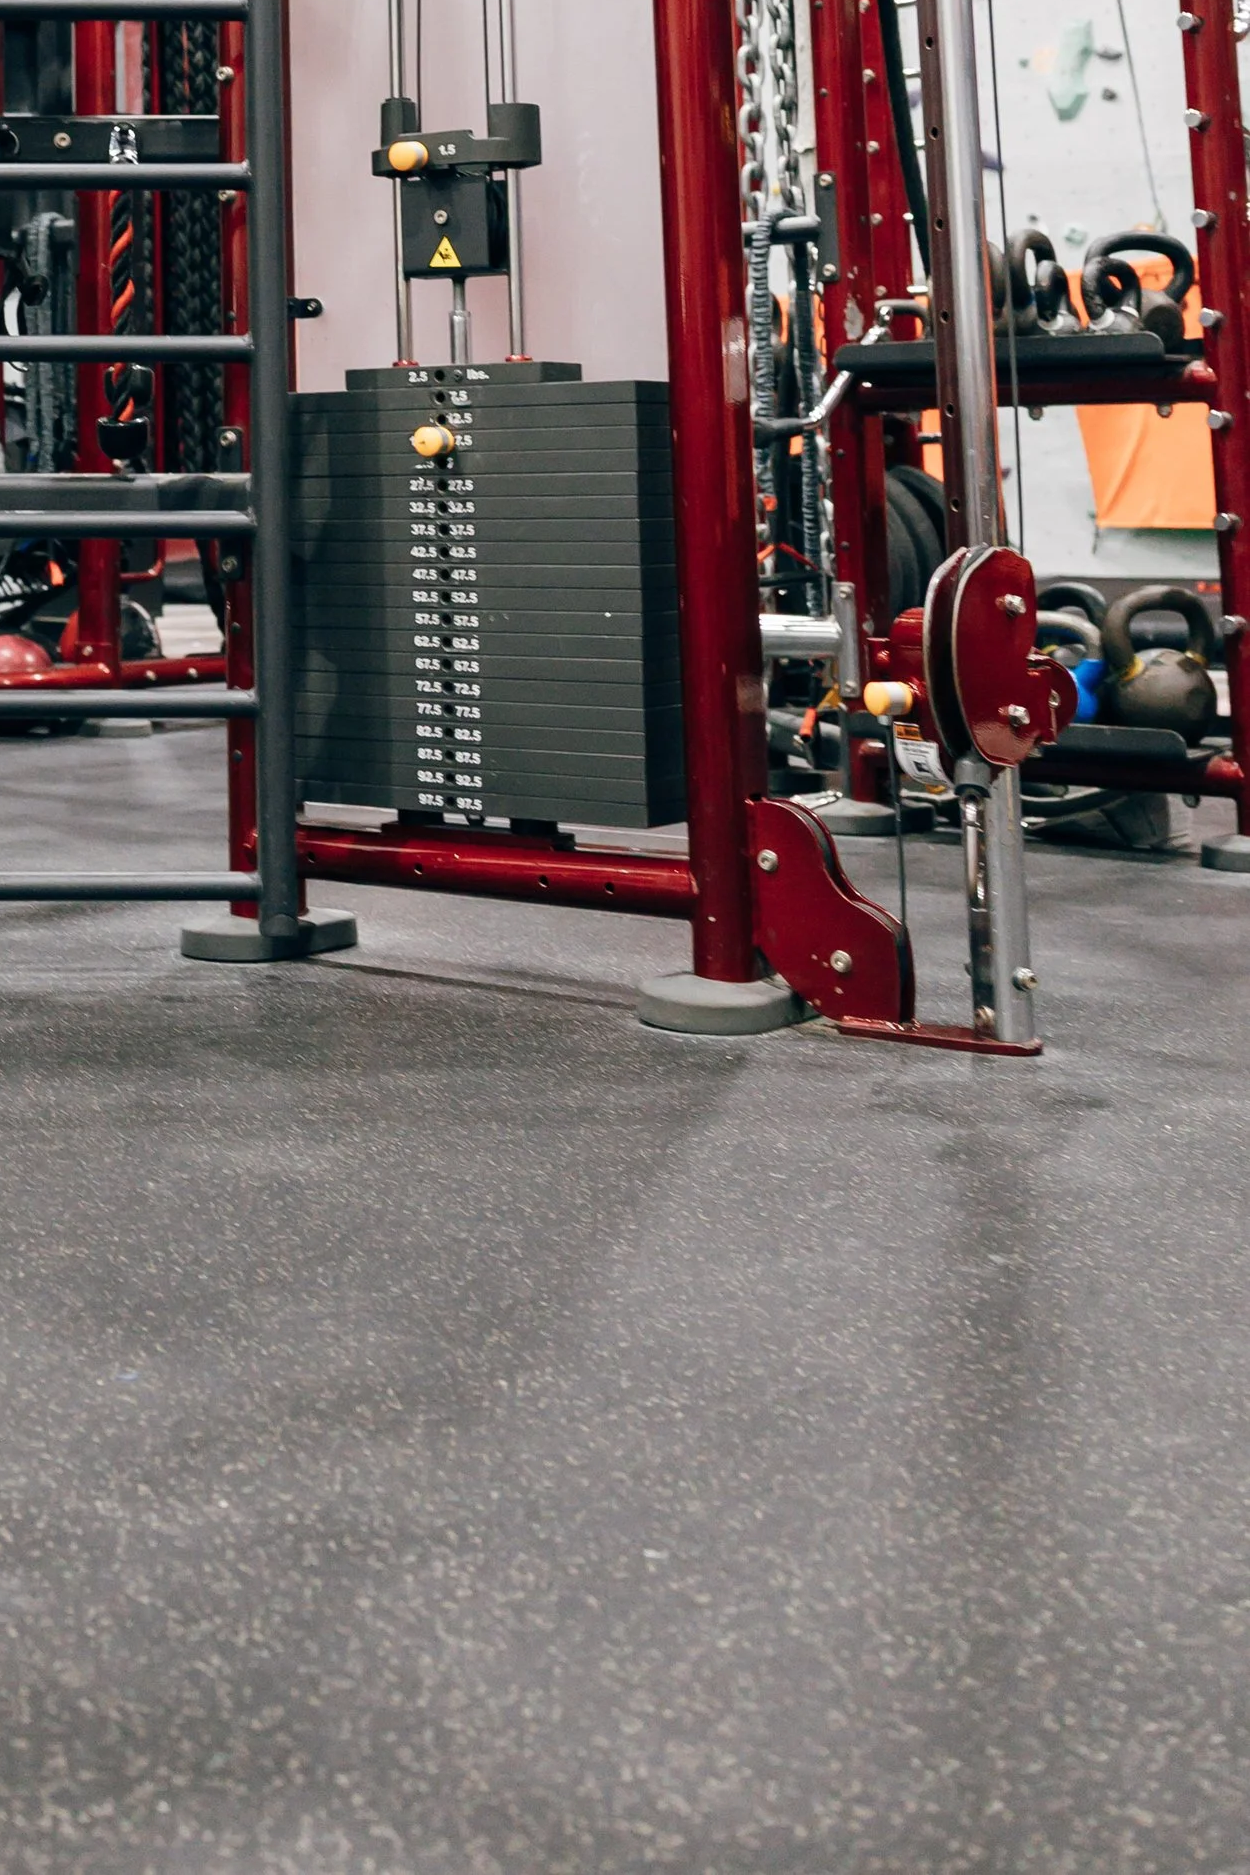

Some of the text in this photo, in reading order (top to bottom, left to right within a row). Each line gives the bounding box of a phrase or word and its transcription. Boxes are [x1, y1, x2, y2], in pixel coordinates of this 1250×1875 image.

[408, 368, 490, 383] 2.5 lbs.
[448, 479, 474, 492] 27.5
[409, 500, 475, 514] 32.5 32.5
[410, 524, 476, 536] 37.5 37.5
[410, 546, 477, 559] 42.5 42.5
[412, 568, 478, 581] 47.5 47.5
[412, 591, 479, 604] 52.5 52.5
[414, 613, 480, 627] 57.5 57.5
[414, 635, 480, 651] 62.5 62.5
[415, 657, 480, 673] 67.5 67.5
[415, 680, 481, 697] 72.5 72.5
[416, 702, 481, 719] 77.5 77.5
[416, 725, 482, 742] 82.5 82.5
[417, 747, 482, 765] 87.5 87.5
[417, 770, 483, 788] 92.5 92.5
[418, 793, 483, 811] 97.5 97.5
